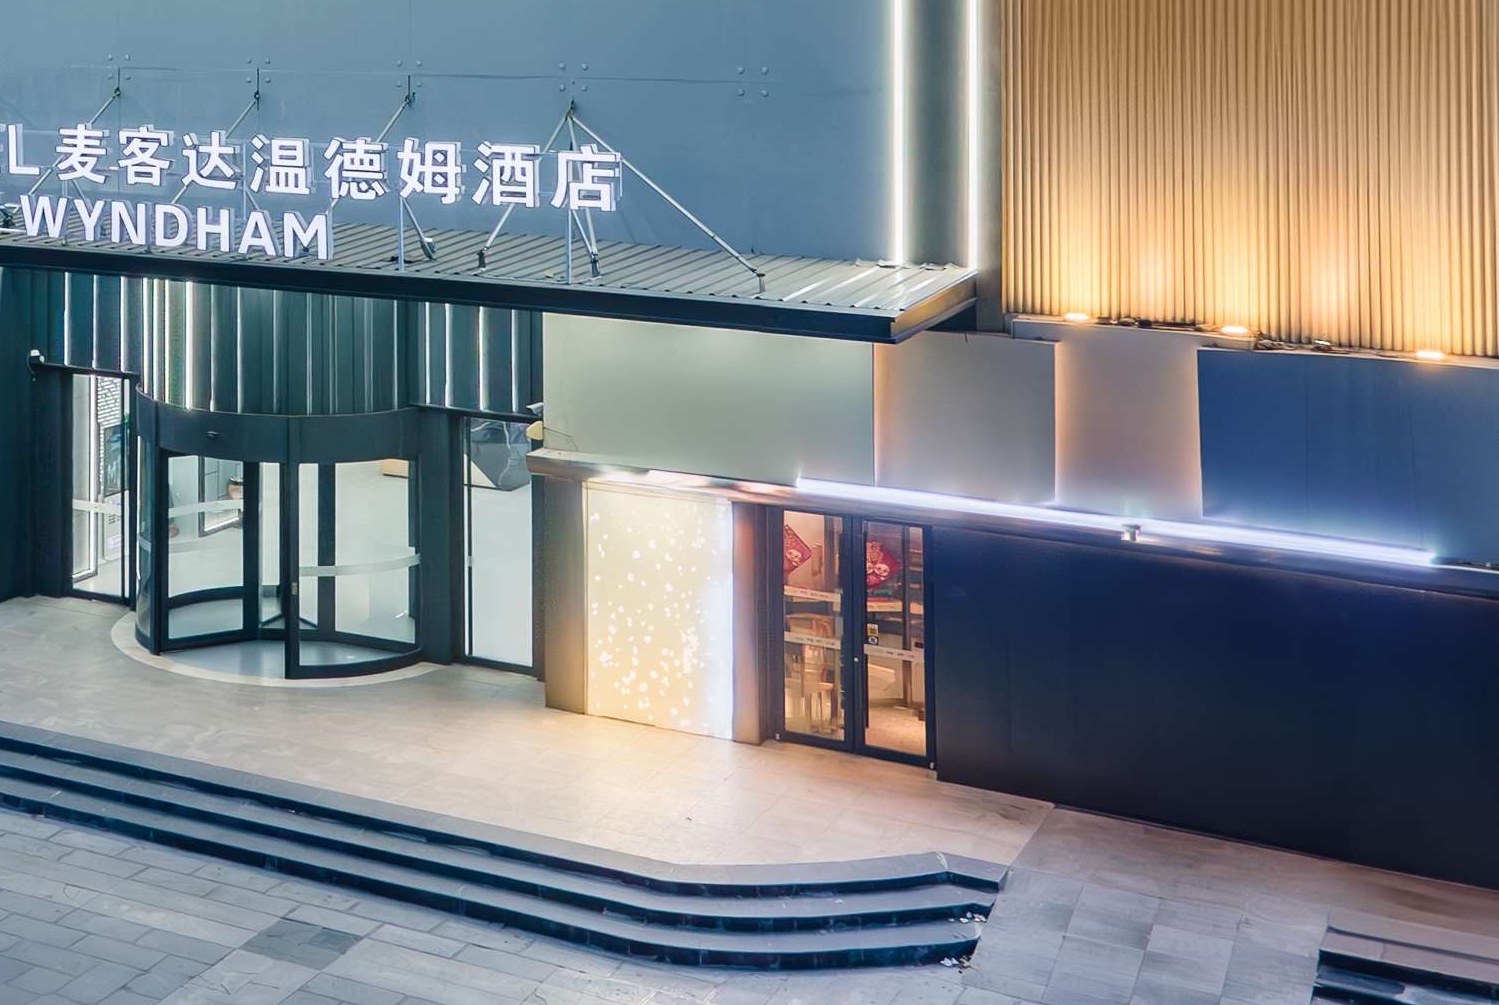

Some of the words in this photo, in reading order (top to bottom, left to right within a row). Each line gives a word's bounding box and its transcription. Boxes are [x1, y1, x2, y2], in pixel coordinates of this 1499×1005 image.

[54, 122, 622, 212] 麦客达温德姆酒店
[19, 193, 334, 261] WYNDHAM
